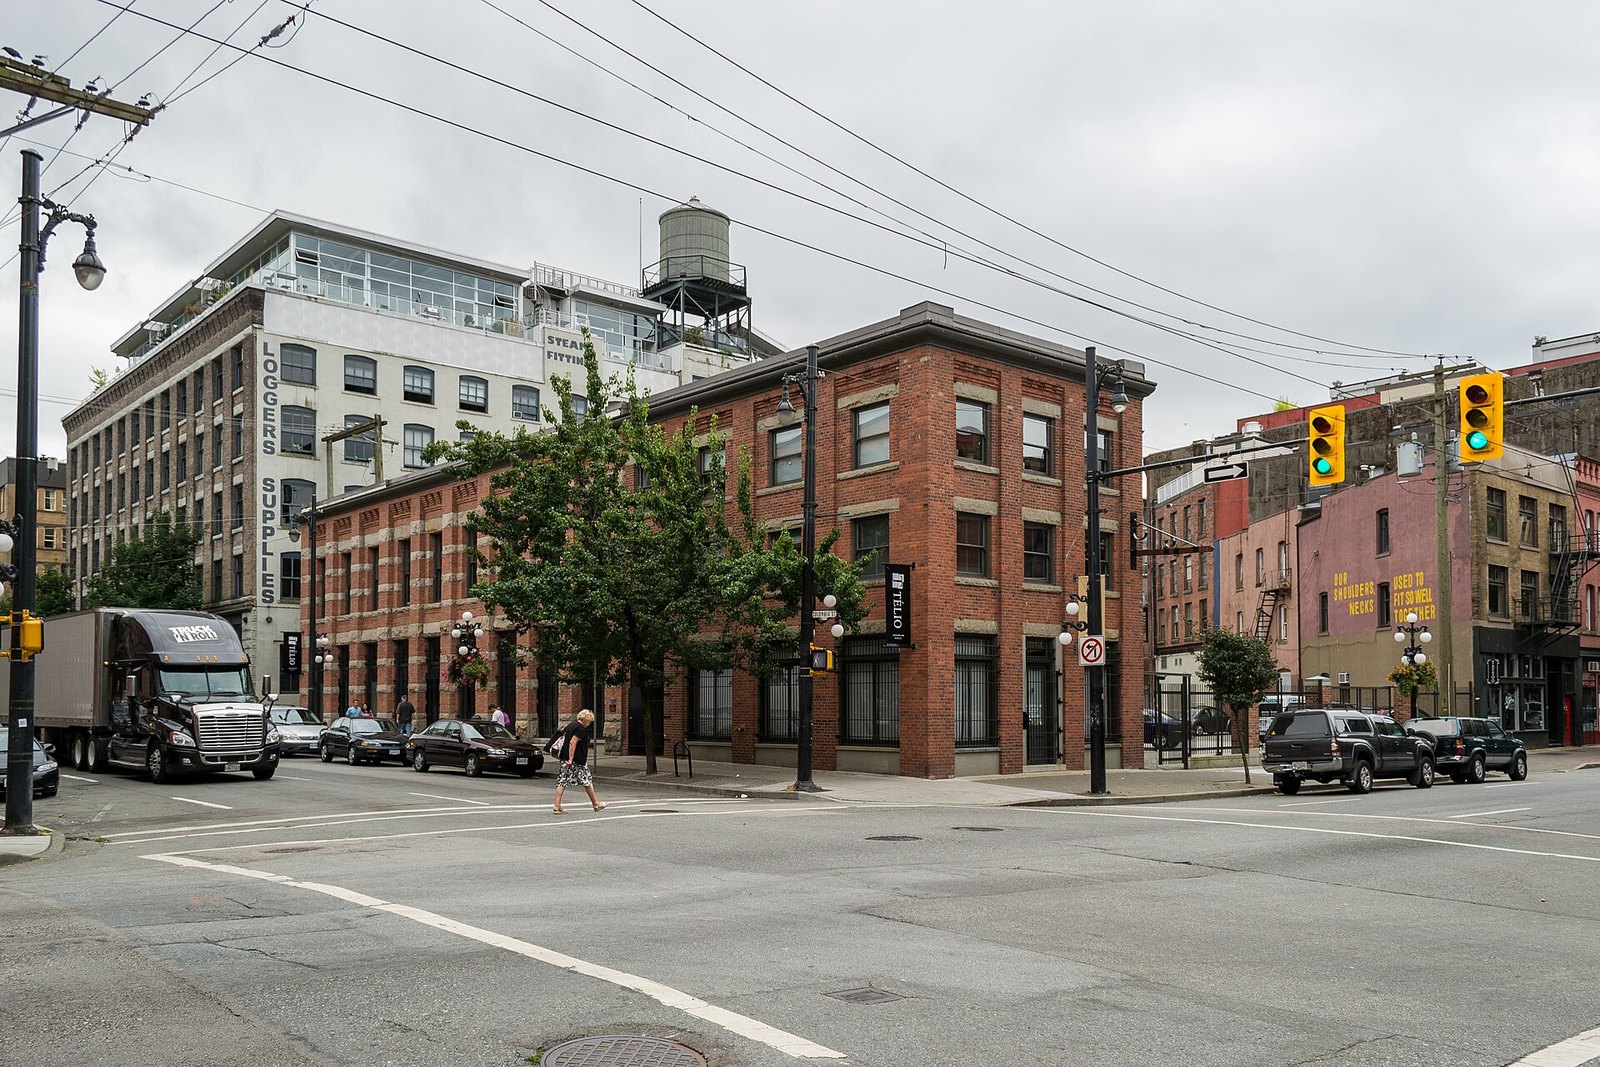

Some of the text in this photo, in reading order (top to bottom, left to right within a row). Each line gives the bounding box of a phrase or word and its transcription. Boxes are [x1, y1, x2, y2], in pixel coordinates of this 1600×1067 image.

[546, 350, 584, 366] FITTIN
[261, 341, 278, 604] LOGGERS SUPPLIES
[1333, 572, 1348, 586] OUR
[1393, 571, 1424, 590] USED TO
[1333, 581, 1376, 601] SHOULDERS,
[1393, 587, 1433, 607] FIT SO WELL
[893, 591, 904, 629] TÉLIO
[1349, 599, 1374, 615] NECKS
[289, 645, 298, 666] TÉLIO
